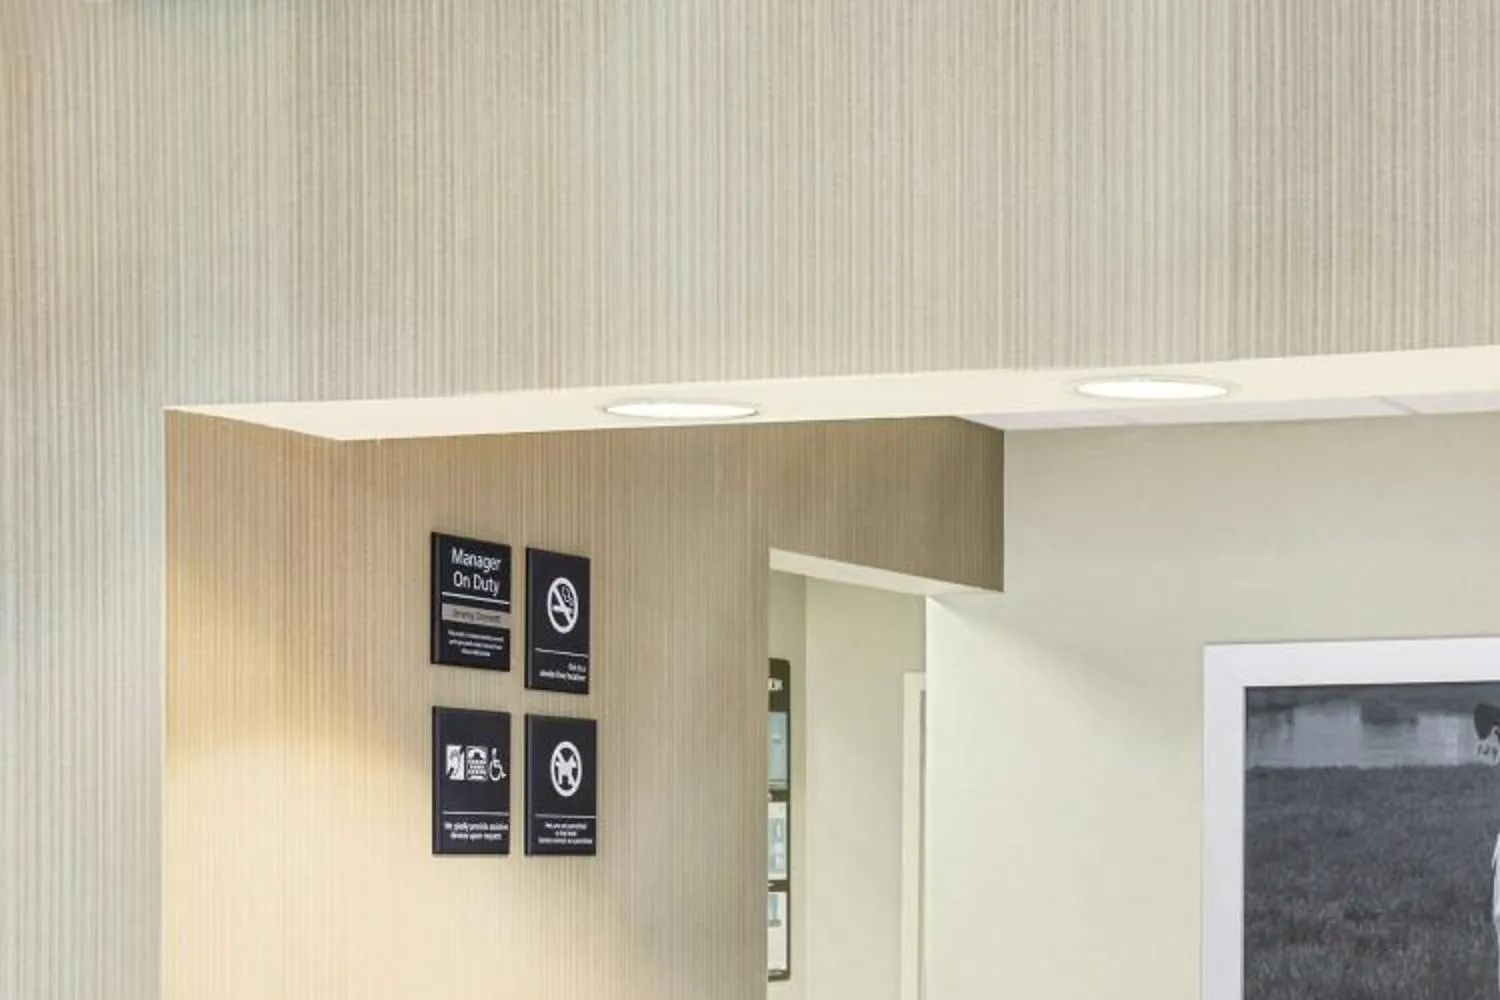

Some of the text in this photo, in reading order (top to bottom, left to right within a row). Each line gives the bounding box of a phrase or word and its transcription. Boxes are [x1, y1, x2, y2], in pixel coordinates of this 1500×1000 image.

[451, 547, 501, 573] Manager
[453, 570, 500, 597] On Duty
